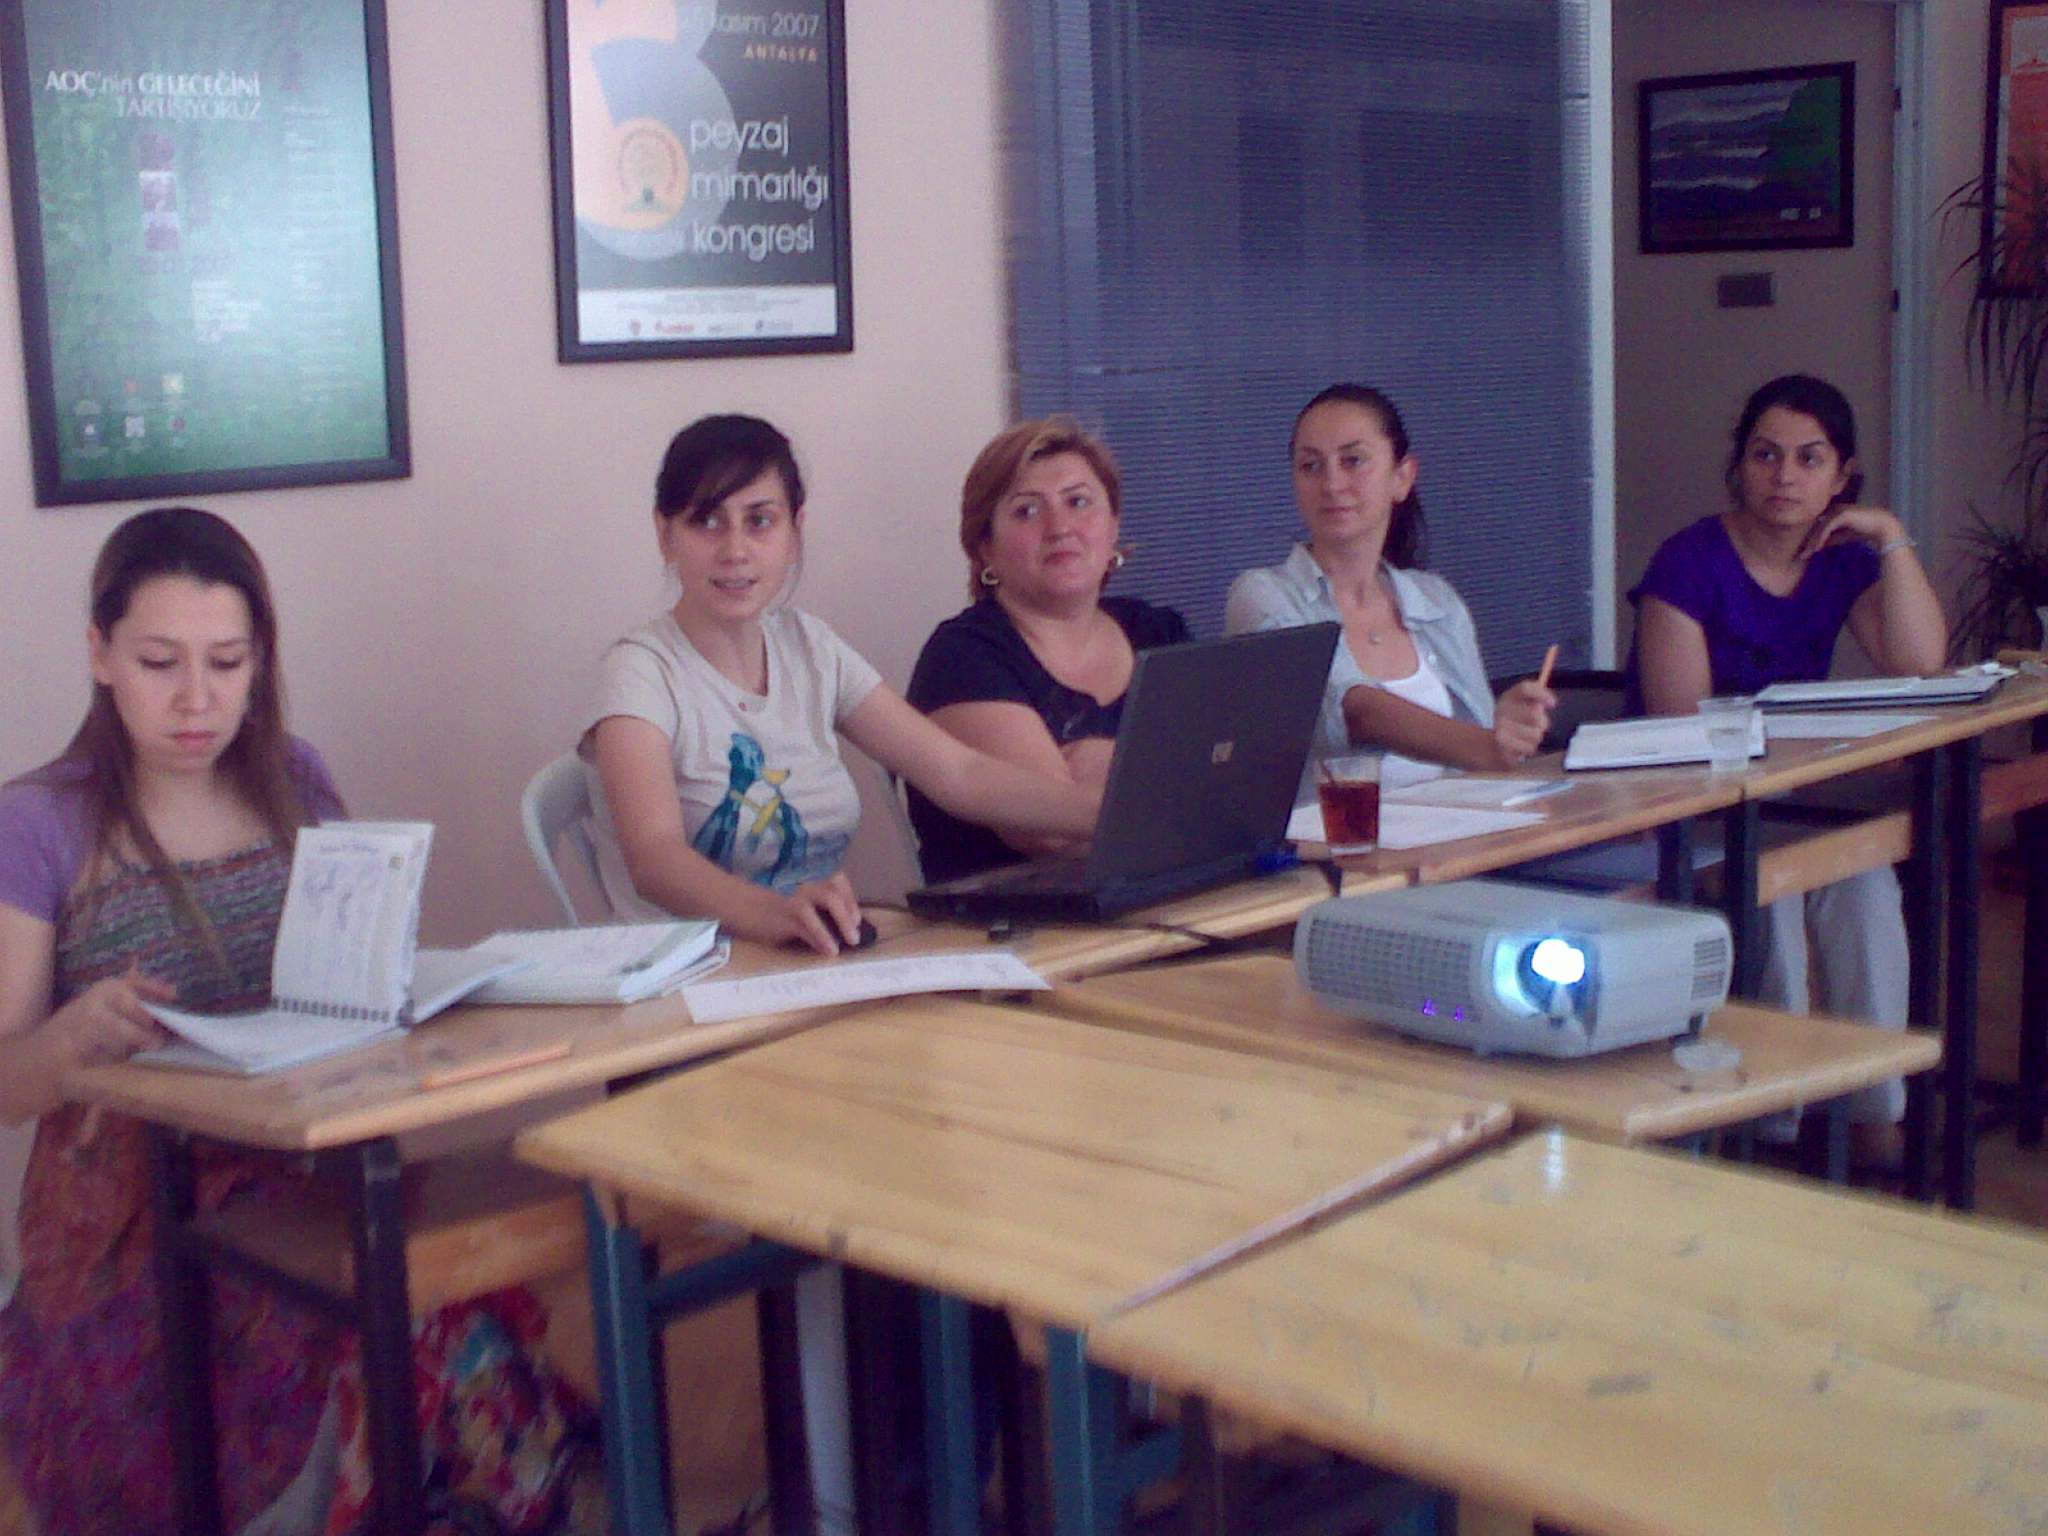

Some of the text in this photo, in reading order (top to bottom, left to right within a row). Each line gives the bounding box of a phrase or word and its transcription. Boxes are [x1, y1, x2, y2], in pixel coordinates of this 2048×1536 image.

[770, 11, 820, 36] 2007
[743, 43, 818, 62] ANTALYA
[690, 115, 789, 157] peyzaj
[691, 165, 829, 211] mimarlığı
[691, 218, 815, 262] kongresi
